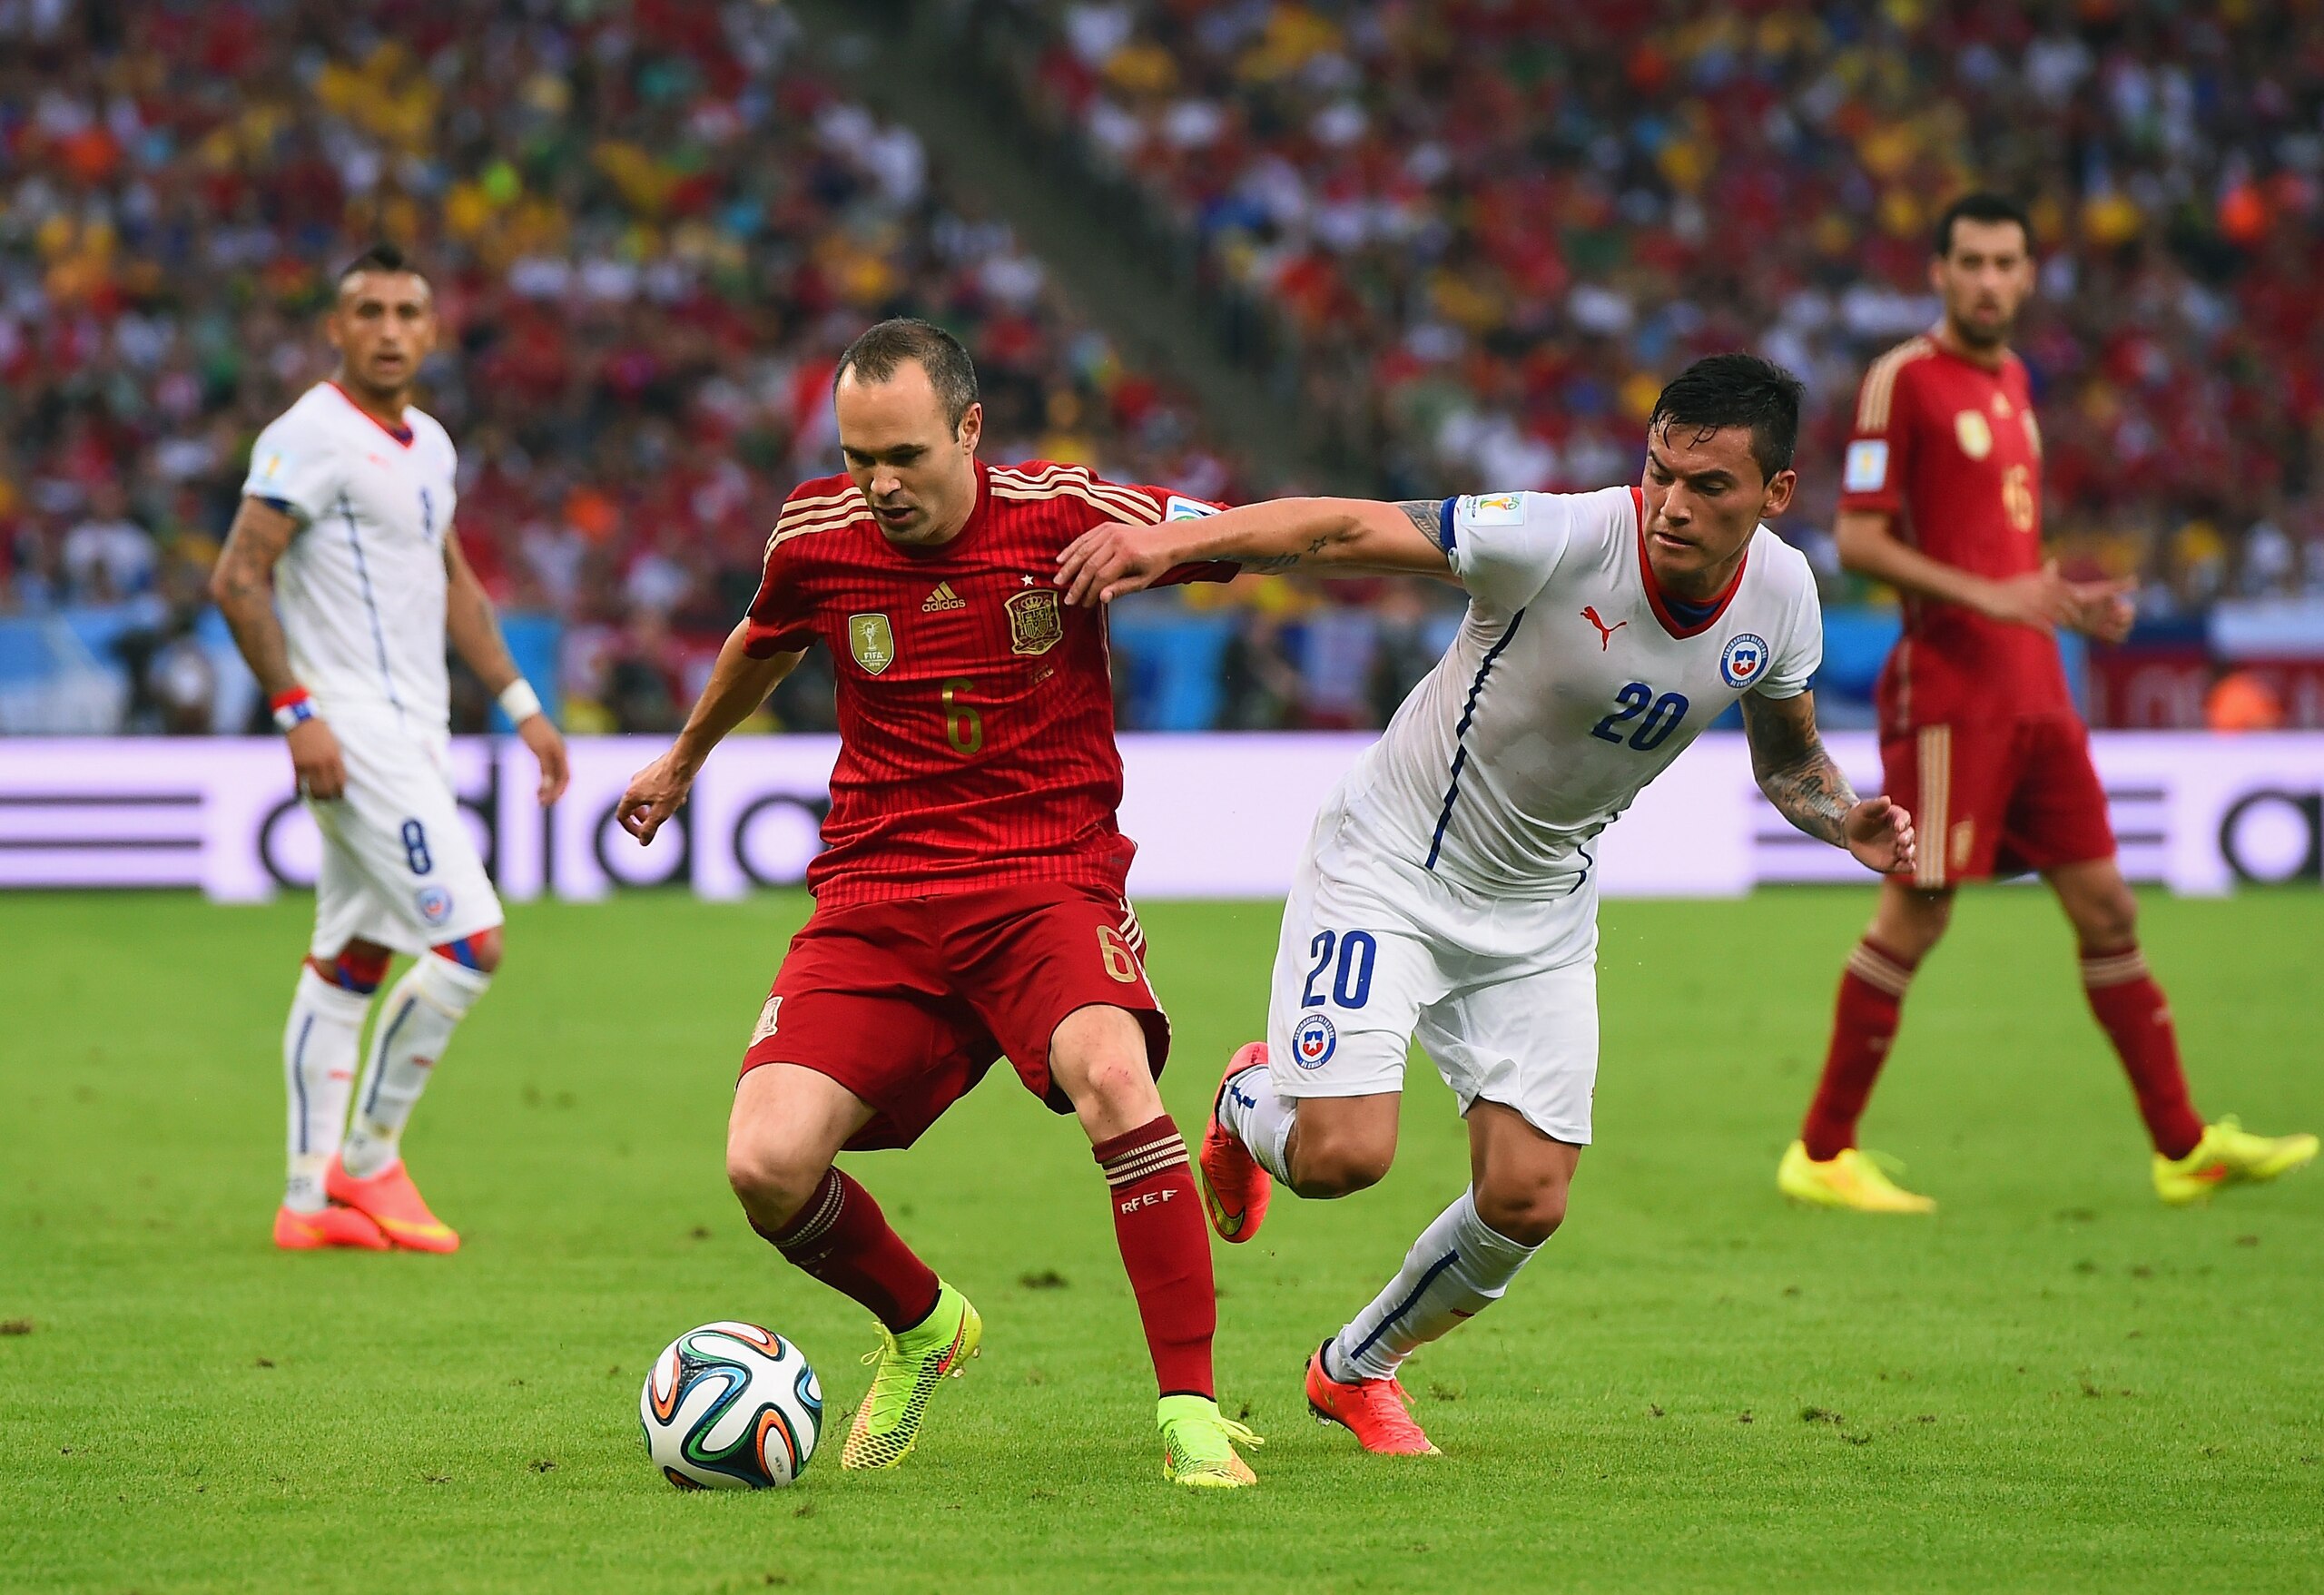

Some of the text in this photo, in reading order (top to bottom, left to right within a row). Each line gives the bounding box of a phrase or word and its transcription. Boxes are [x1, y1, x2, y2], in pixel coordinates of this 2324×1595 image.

[921, 598, 966, 612] adidas
[863, 652, 883, 660] FIFA
[941, 677, 982, 754] 6
[1591, 682, 1689, 752] 20
[402, 819, 431, 875] 8
[1096, 924, 1137, 983] 6
[1301, 930, 1376, 1009] 20
[1121, 1189, 1178, 1215] RFEF
